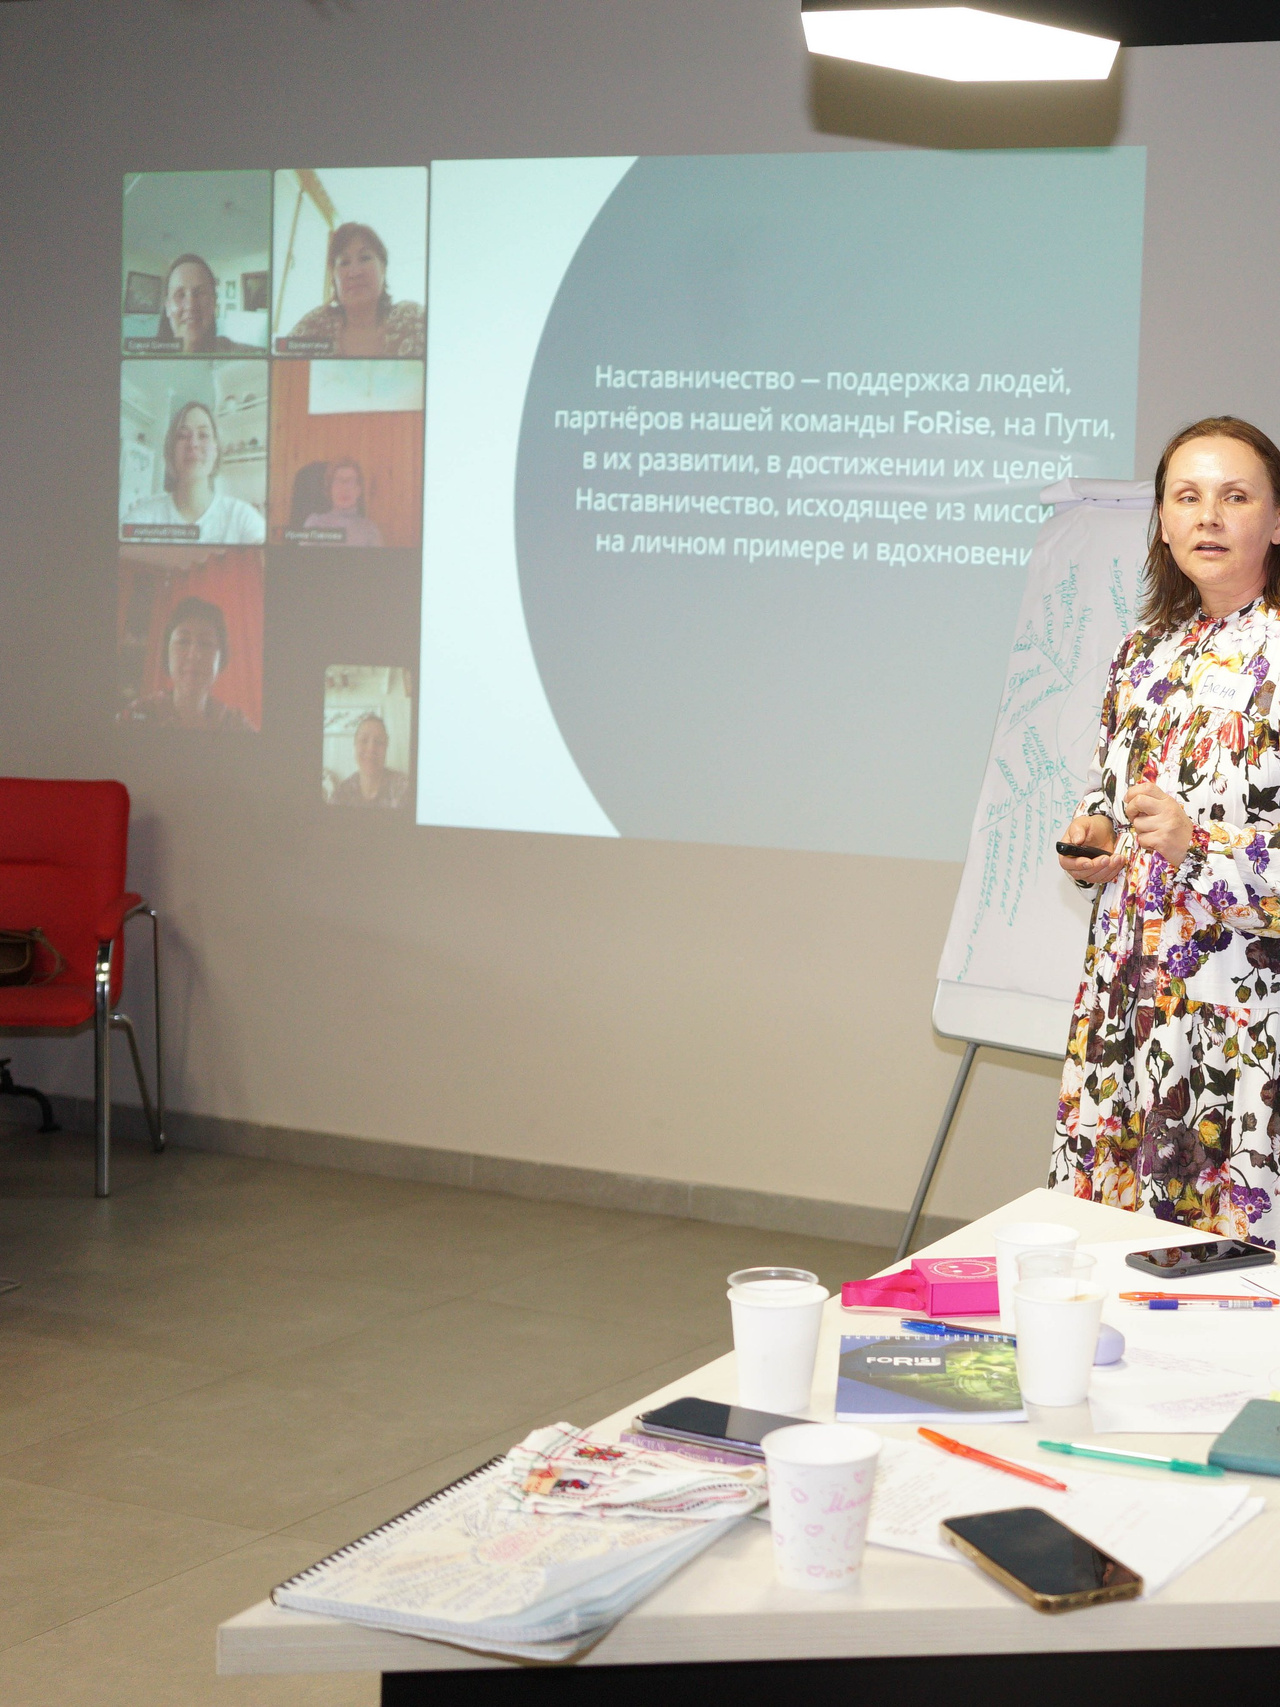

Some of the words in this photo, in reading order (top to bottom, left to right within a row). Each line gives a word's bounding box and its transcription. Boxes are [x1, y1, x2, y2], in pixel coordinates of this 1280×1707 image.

[595, 365, 795, 391] Наставничество
[827, 371, 970, 397] поддержка
[976, 370, 1071, 397] людей,
[555, 405, 682, 434] партнёров
[689, 405, 773, 432] нашей
[781, 412, 894, 435] команды
[903, 410, 996, 439] FoRise,
[1004, 415, 1036, 436] на
[1045, 413, 1115, 443] Пути,
[583, 451, 597, 469] в
[602, 451, 631, 470] их
[639, 451, 760, 476] развитии,
[767, 454, 781, 473] в
[787, 454, 945, 479] достижении
[952, 458, 984, 478] их
[576, 488, 779, 520] Наставничество,
[786, 499, 928, 523] исходящее
[935, 502, 966, 522] из
[974, 501, 1053, 524] мисси
[595, 534, 624, 552] на
[630, 535, 726, 558] личном
[733, 538, 843, 562] примере
[853, 541, 868, 559] и
[876, 541, 1032, 568] вдохновени
[1200, 675, 1236, 699] Елена
